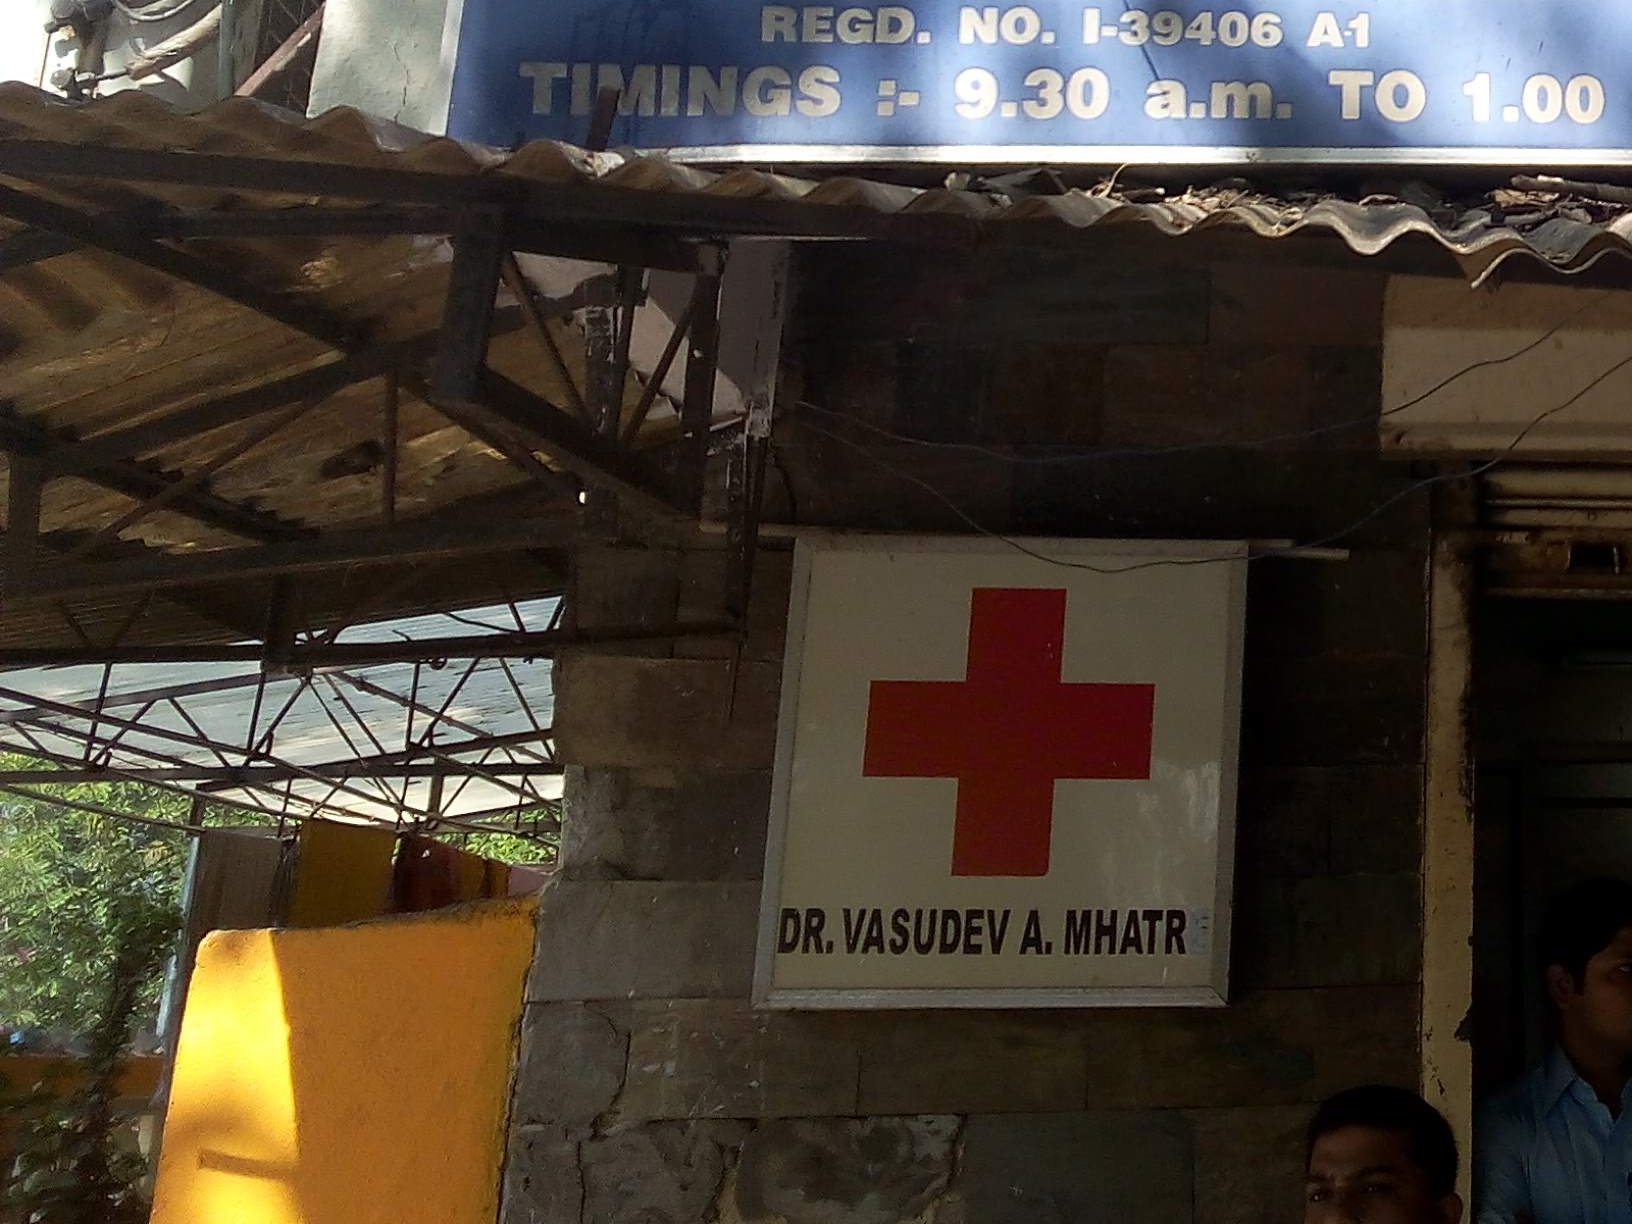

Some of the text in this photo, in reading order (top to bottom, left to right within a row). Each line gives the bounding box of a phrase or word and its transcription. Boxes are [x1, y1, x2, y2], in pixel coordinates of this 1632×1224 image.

[760, 6, 1371, 48] REGD. NO. I-39406 A-1
[519, 60, 844, 118] TIMINGS
[954, 67, 1111, 121] 9.30
[1143, 79, 1294, 121] a.m.
[1328, 69, 1428, 123] TO
[1462, 72, 1605, 126] 1.00
[777, 907, 1209, 957] DR. VASUDEV A. MHATR
